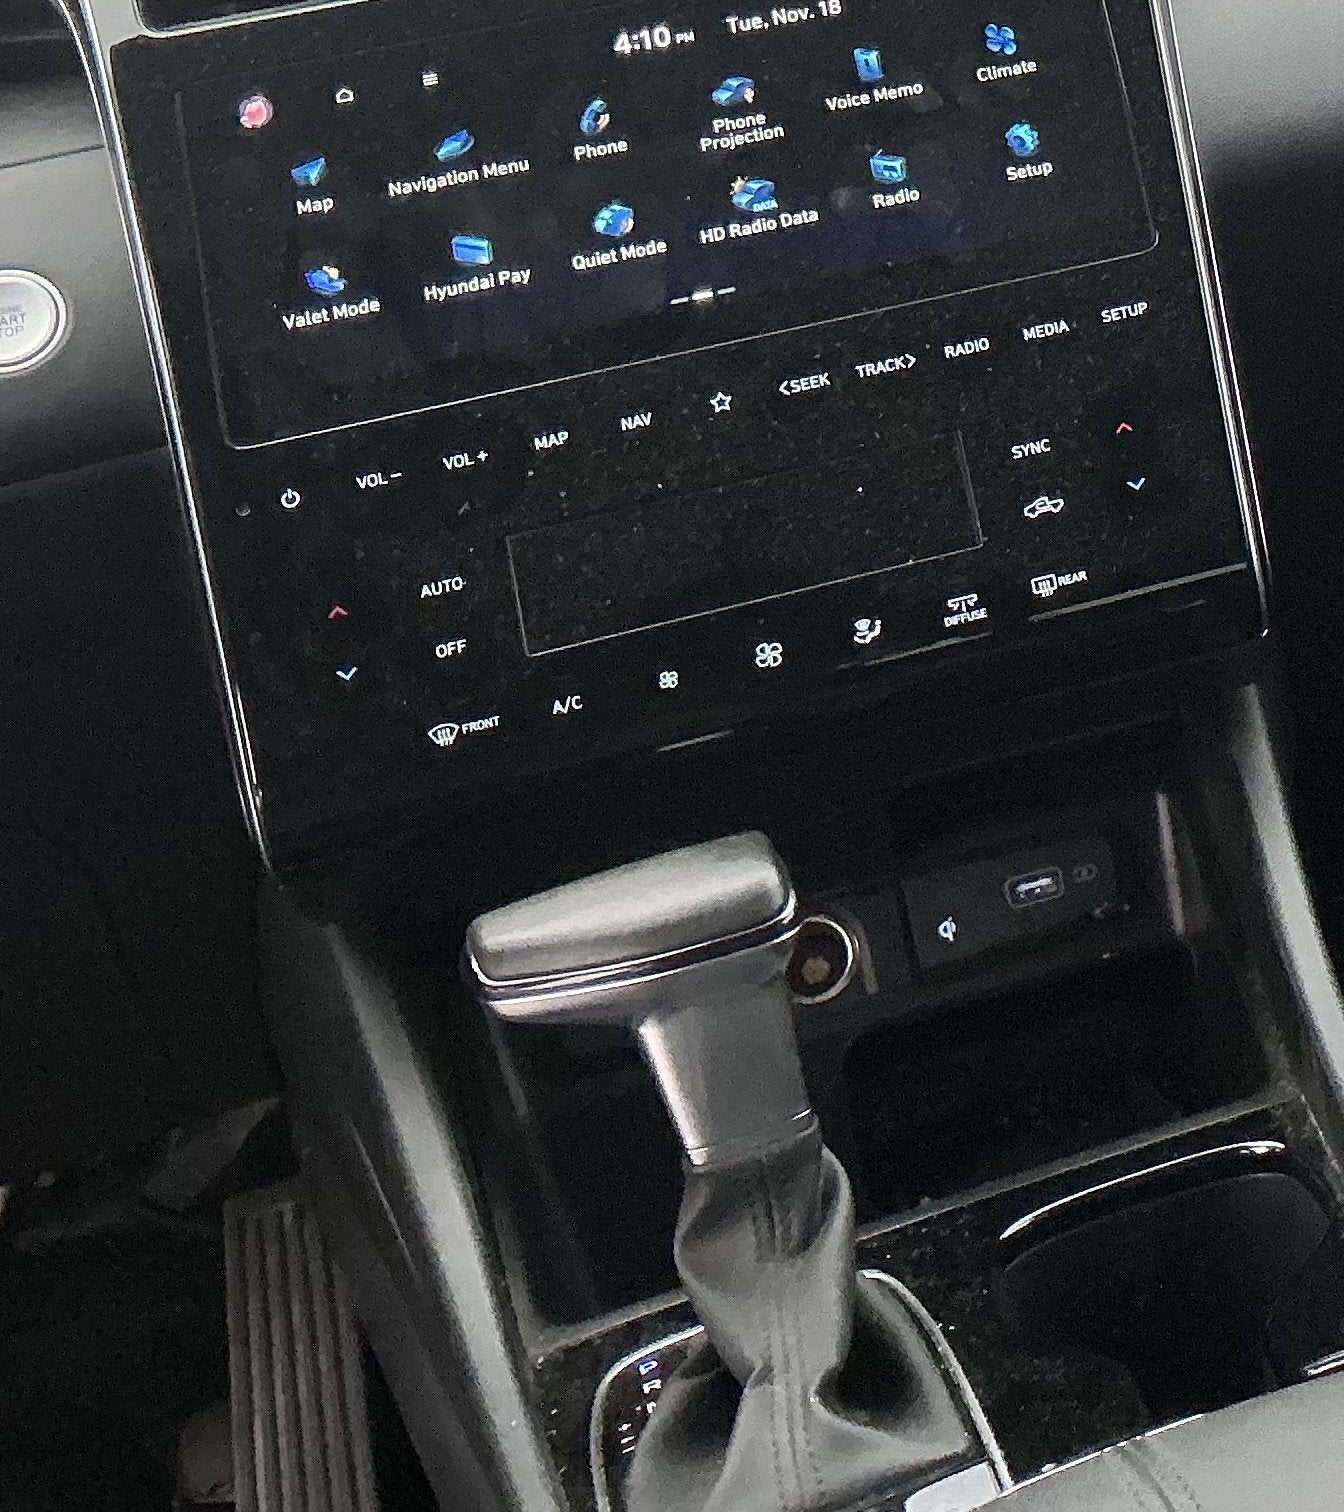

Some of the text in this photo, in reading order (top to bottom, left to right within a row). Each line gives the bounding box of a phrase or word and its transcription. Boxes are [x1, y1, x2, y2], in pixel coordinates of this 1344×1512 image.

[726, 15, 769, 34] Tue,
[771, 7, 815, 25] Nov.
[613, 23, 695, 56] 4:10 PM
[977, 61, 1037, 81] Climate
[825, 83, 923, 111] Voice Memo
[712, 112, 768, 134] Phone
[700, 126, 785, 151] Projection
[574, 141, 628, 161] Phone
[388, 160, 529, 196] Navigation Menu
[1006, 162, 1053, 180] Setup
[297, 198, 333, 215] Map
[872, 188, 919, 208] Radio
[700, 210, 819, 244] HD Radio Data
[571, 240, 667, 270] Quiet Mode
[424, 269, 530, 301] Hyundai Pay
[283, 298, 380, 330] Valet Mode
[1101, 302, 1147, 322] SETUP
[1022, 320, 1070, 341] MEDIA
[944, 338, 989, 358] RADIO
[621, 412, 652, 431] NAV
[535, 431, 568, 451] MAP
[1011, 439, 1050, 459] SYNC
[420, 576, 464, 598] AUTO
[1058, 571, 1087, 586] REAR
[944, 609, 988, 628] DIFFUSE
[436, 639, 466, 658] OFF
[553, 696, 582, 714] A/C
[462, 716, 499, 734] FRONT
